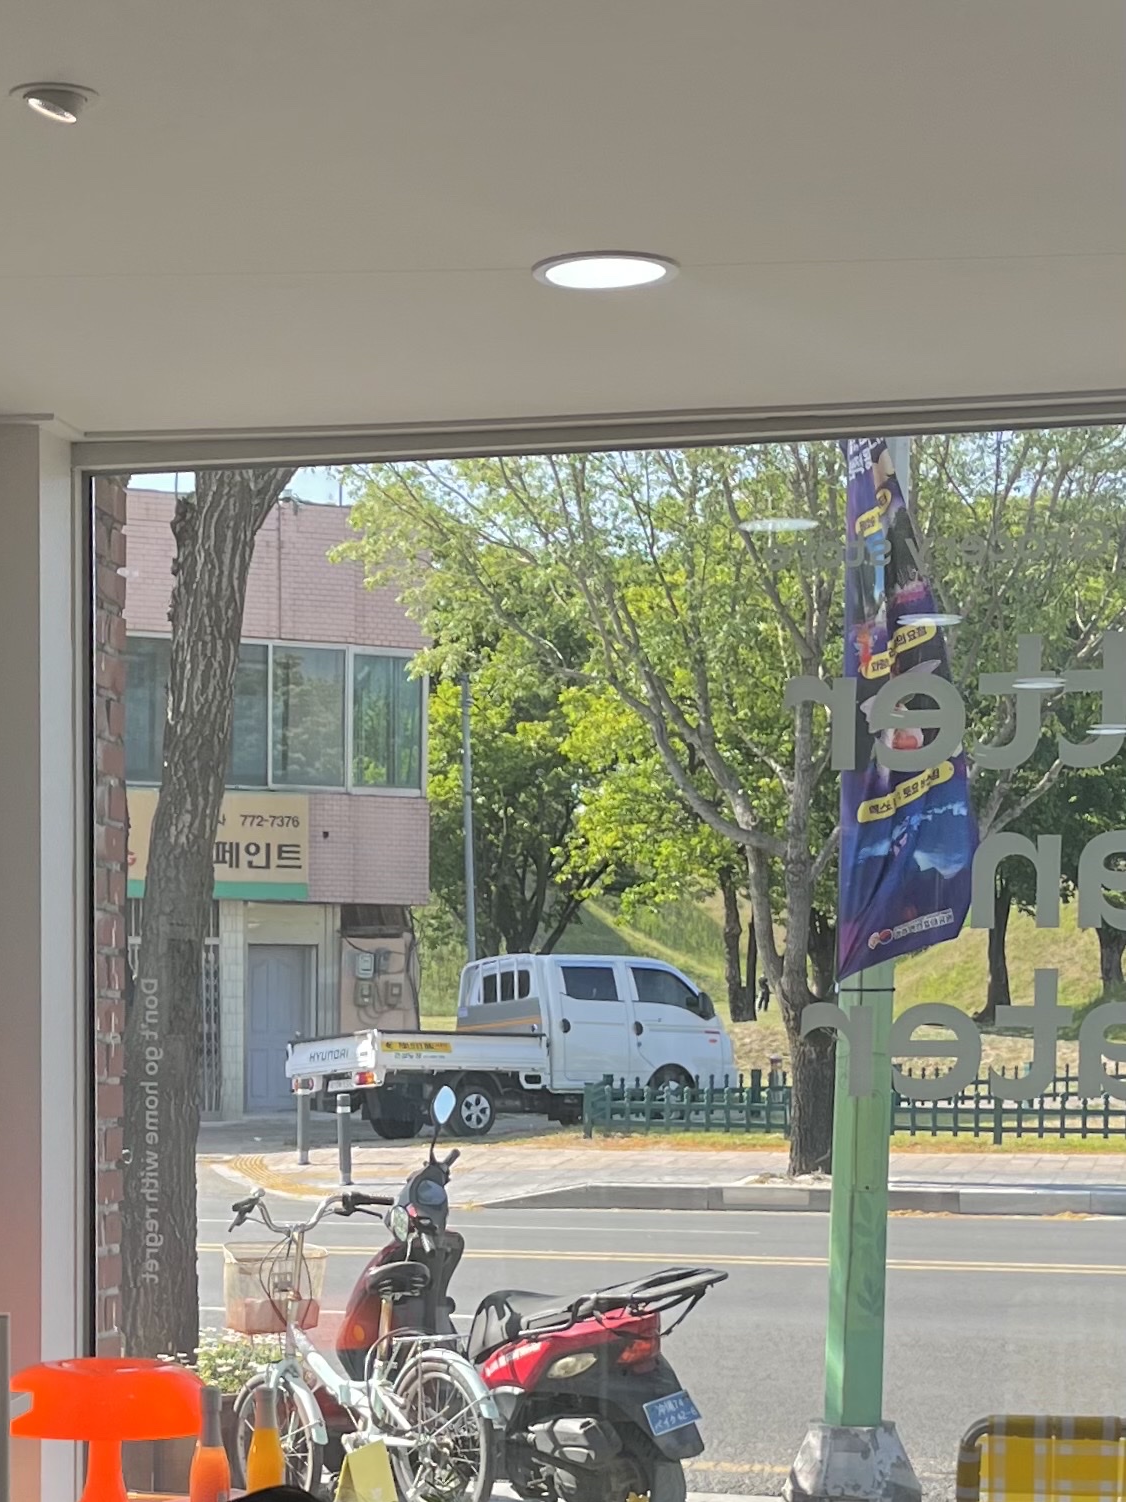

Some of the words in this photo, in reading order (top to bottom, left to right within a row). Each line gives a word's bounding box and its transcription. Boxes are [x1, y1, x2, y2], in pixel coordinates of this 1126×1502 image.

[240, 814, 301, 828] 772-7376
[213, 841, 303, 870] 페인트
[309, 1049, 349, 1062] HYUNDAI
